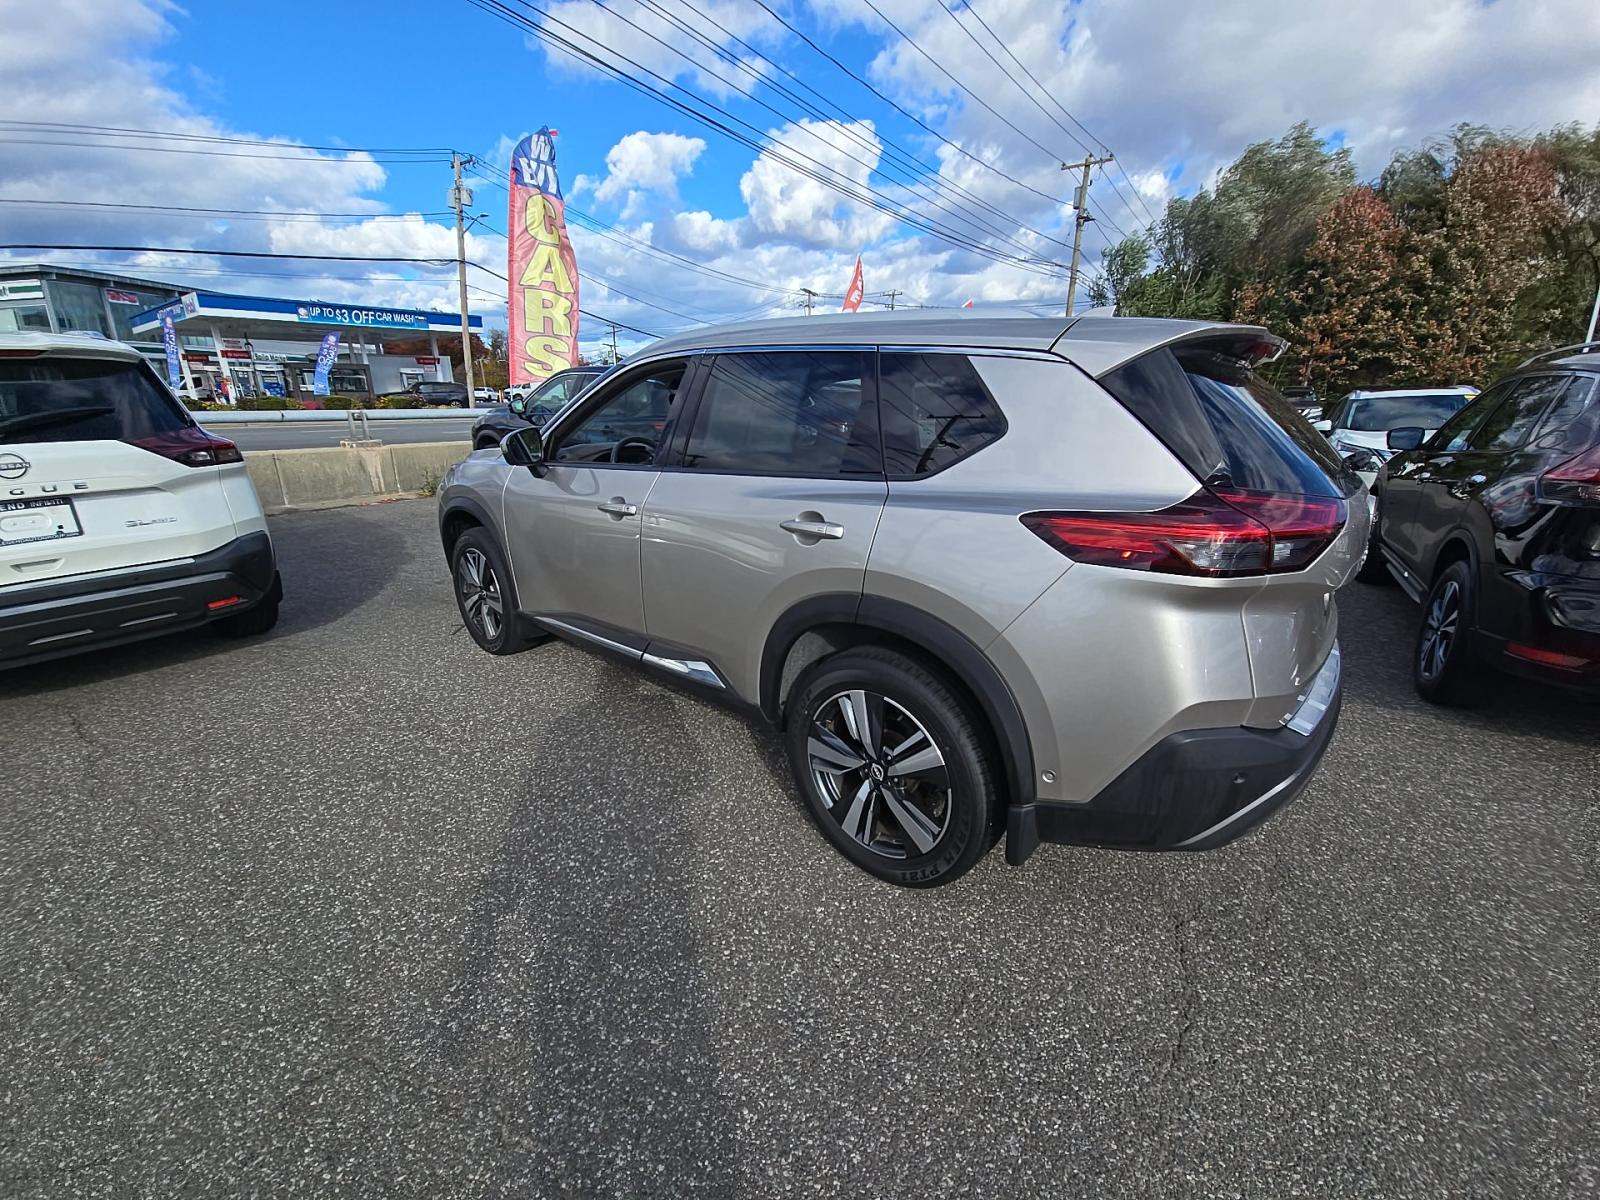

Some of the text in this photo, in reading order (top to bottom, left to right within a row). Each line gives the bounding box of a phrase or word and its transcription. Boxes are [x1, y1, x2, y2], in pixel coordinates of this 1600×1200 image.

[309, 307, 321, 317] UP
[323, 308, 334, 318] TO
[335, 309, 349, 323] $3
[351, 310, 375, 324] OFF
[375, 312, 392, 322] CAR
[393, 313, 414, 323] WASH
[519, 193, 575, 378] CARS
